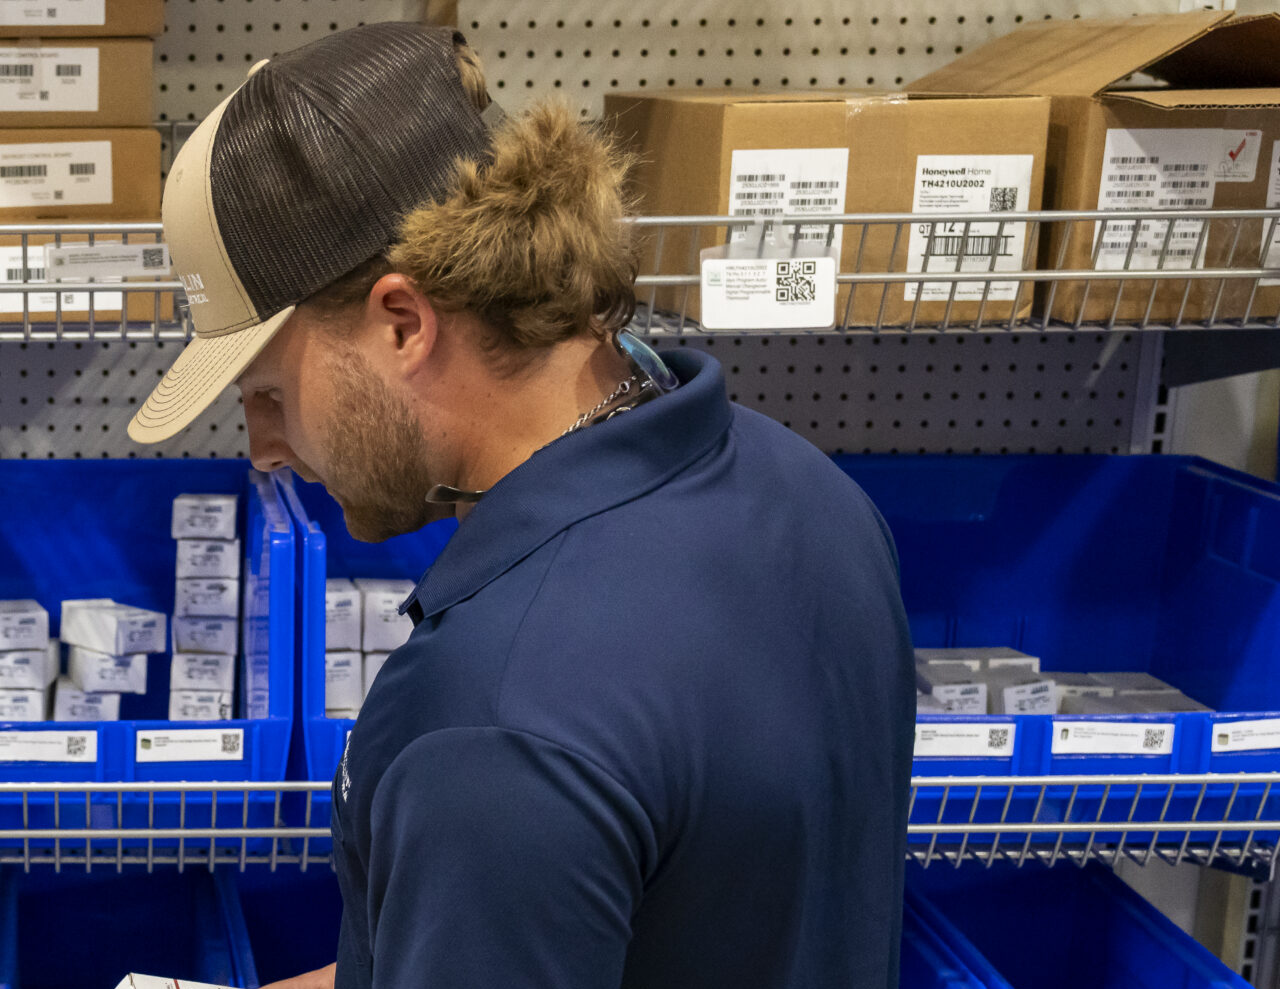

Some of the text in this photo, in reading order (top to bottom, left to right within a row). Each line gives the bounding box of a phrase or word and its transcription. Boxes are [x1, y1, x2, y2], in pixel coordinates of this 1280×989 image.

[922, 168, 992, 177] Honeywell Home
[921, 180, 985, 188] TH4210U2002
